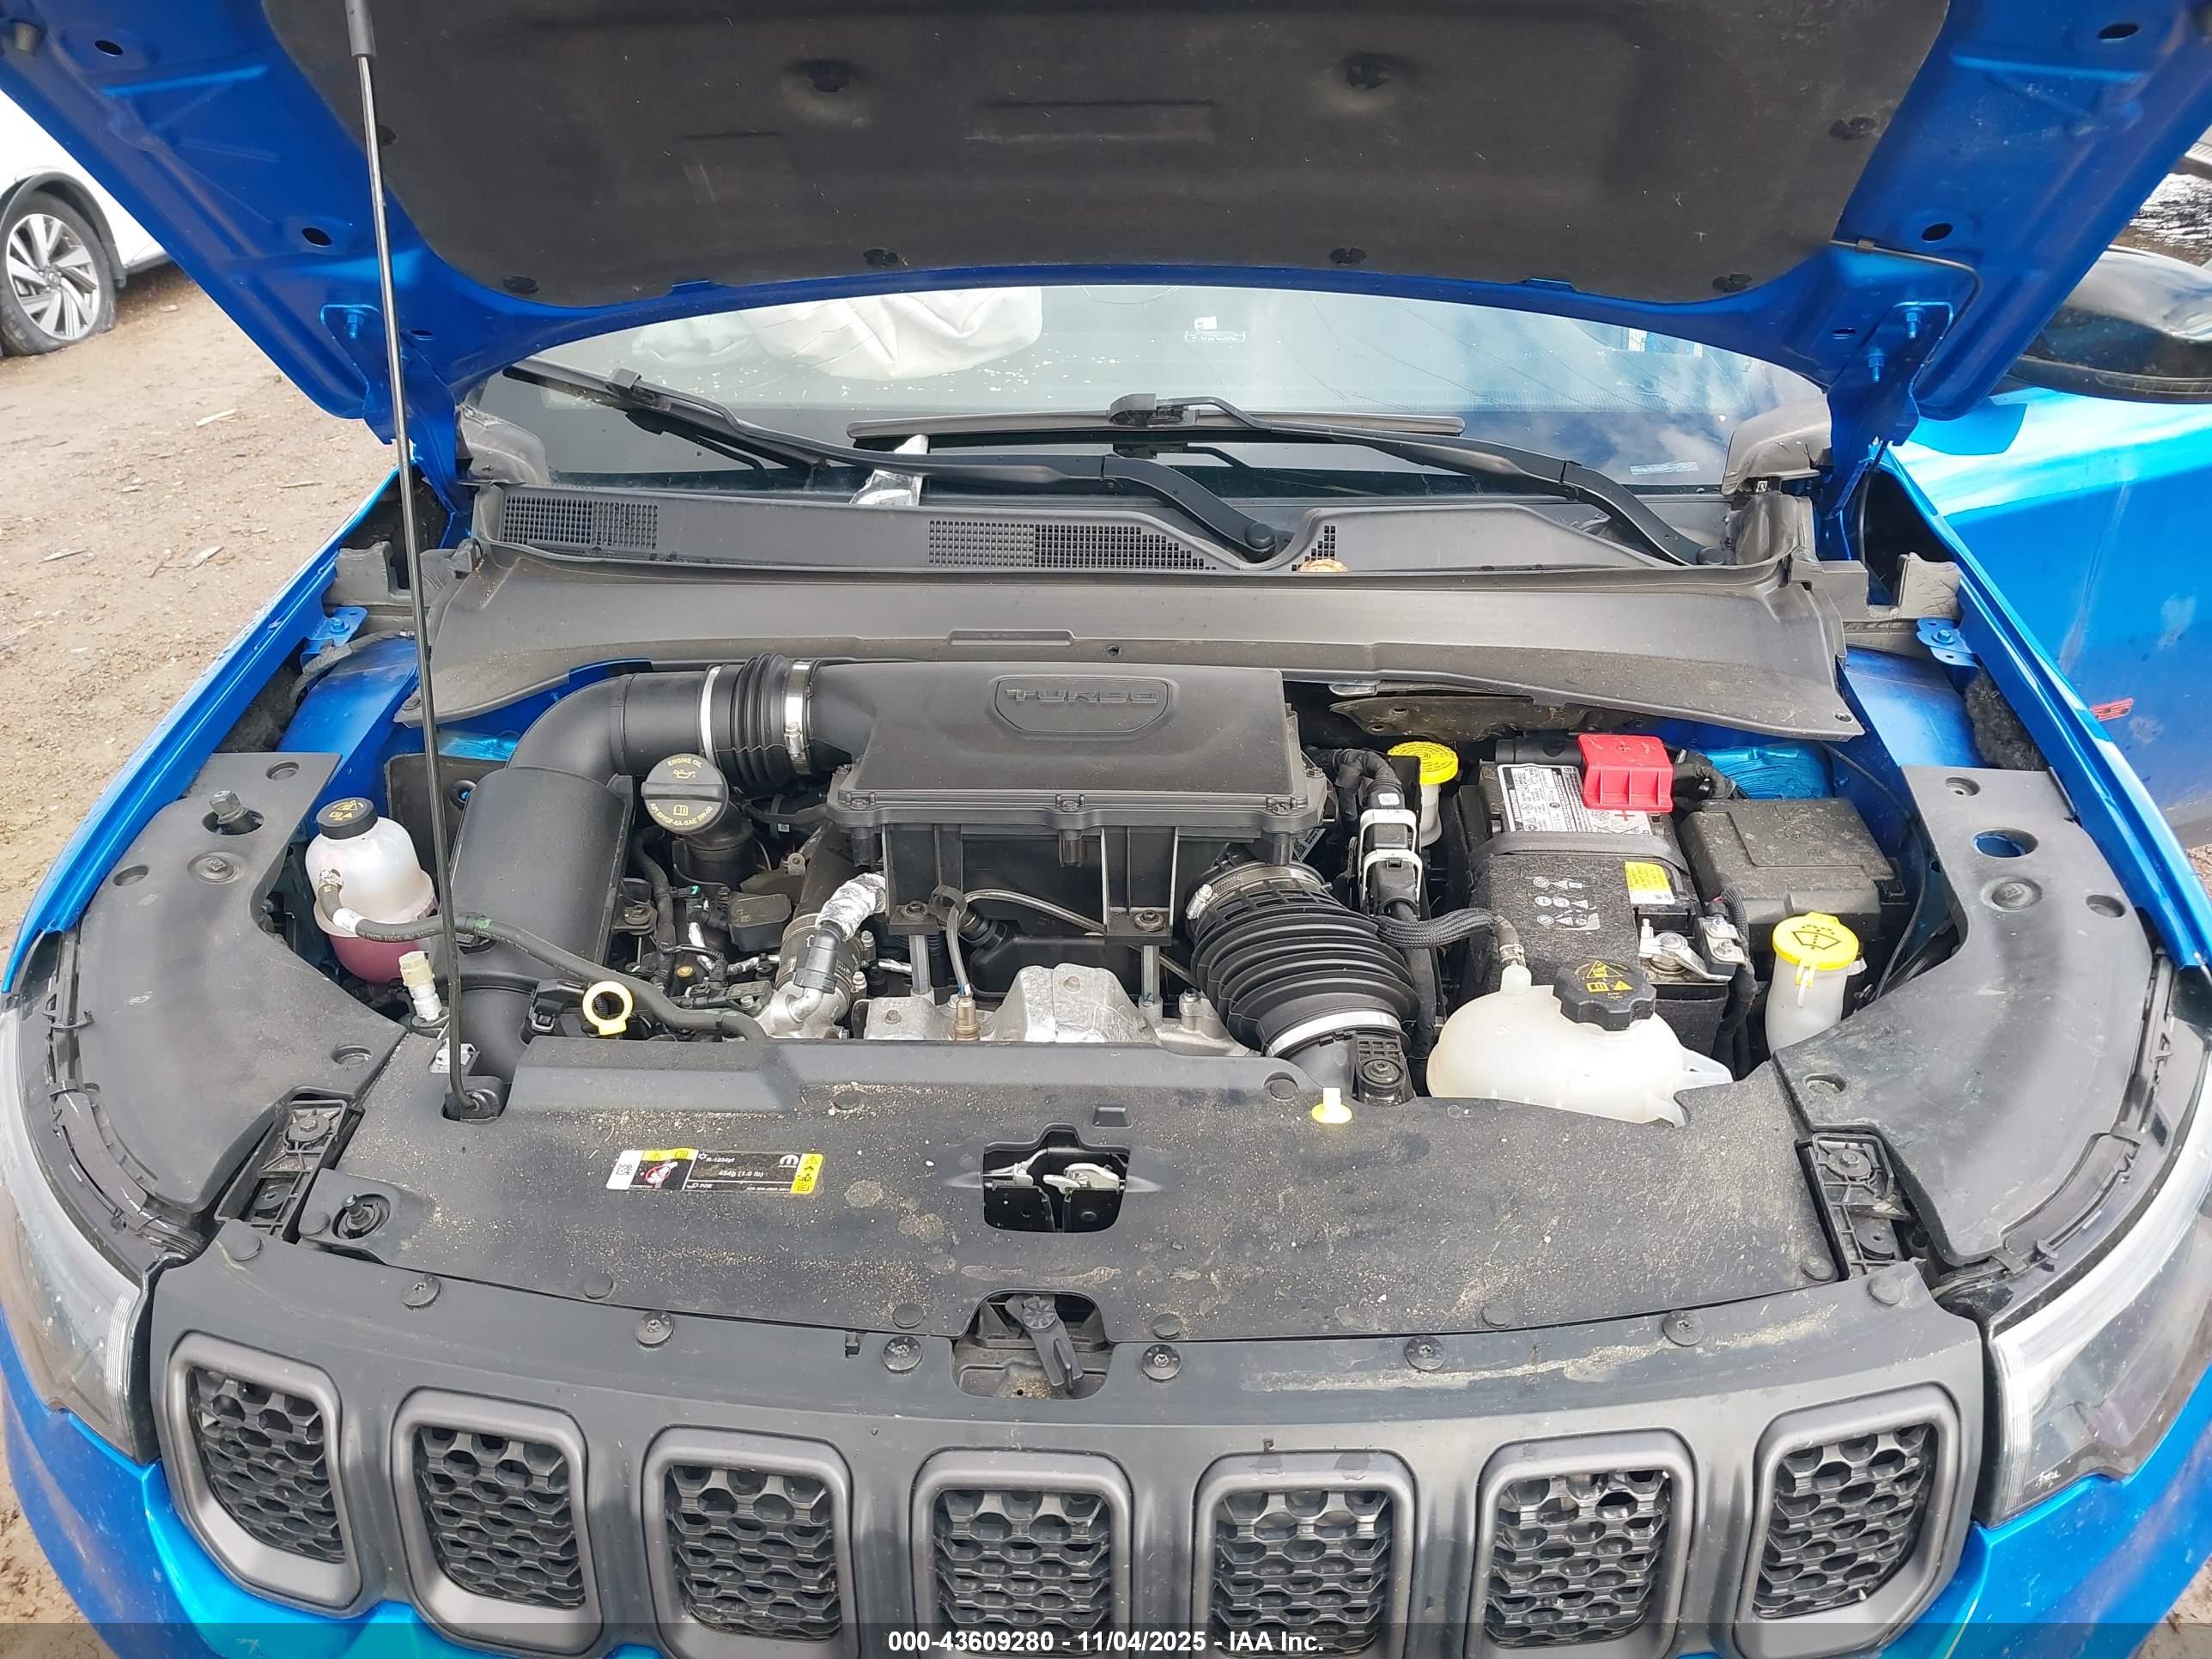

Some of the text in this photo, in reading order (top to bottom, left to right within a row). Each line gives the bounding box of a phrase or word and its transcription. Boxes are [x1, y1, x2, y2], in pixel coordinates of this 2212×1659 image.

[1005, 688, 1160, 704] TURBO
[667, 757, 702, 769] ENGINE OIL
[649, 803, 659, 813] API
